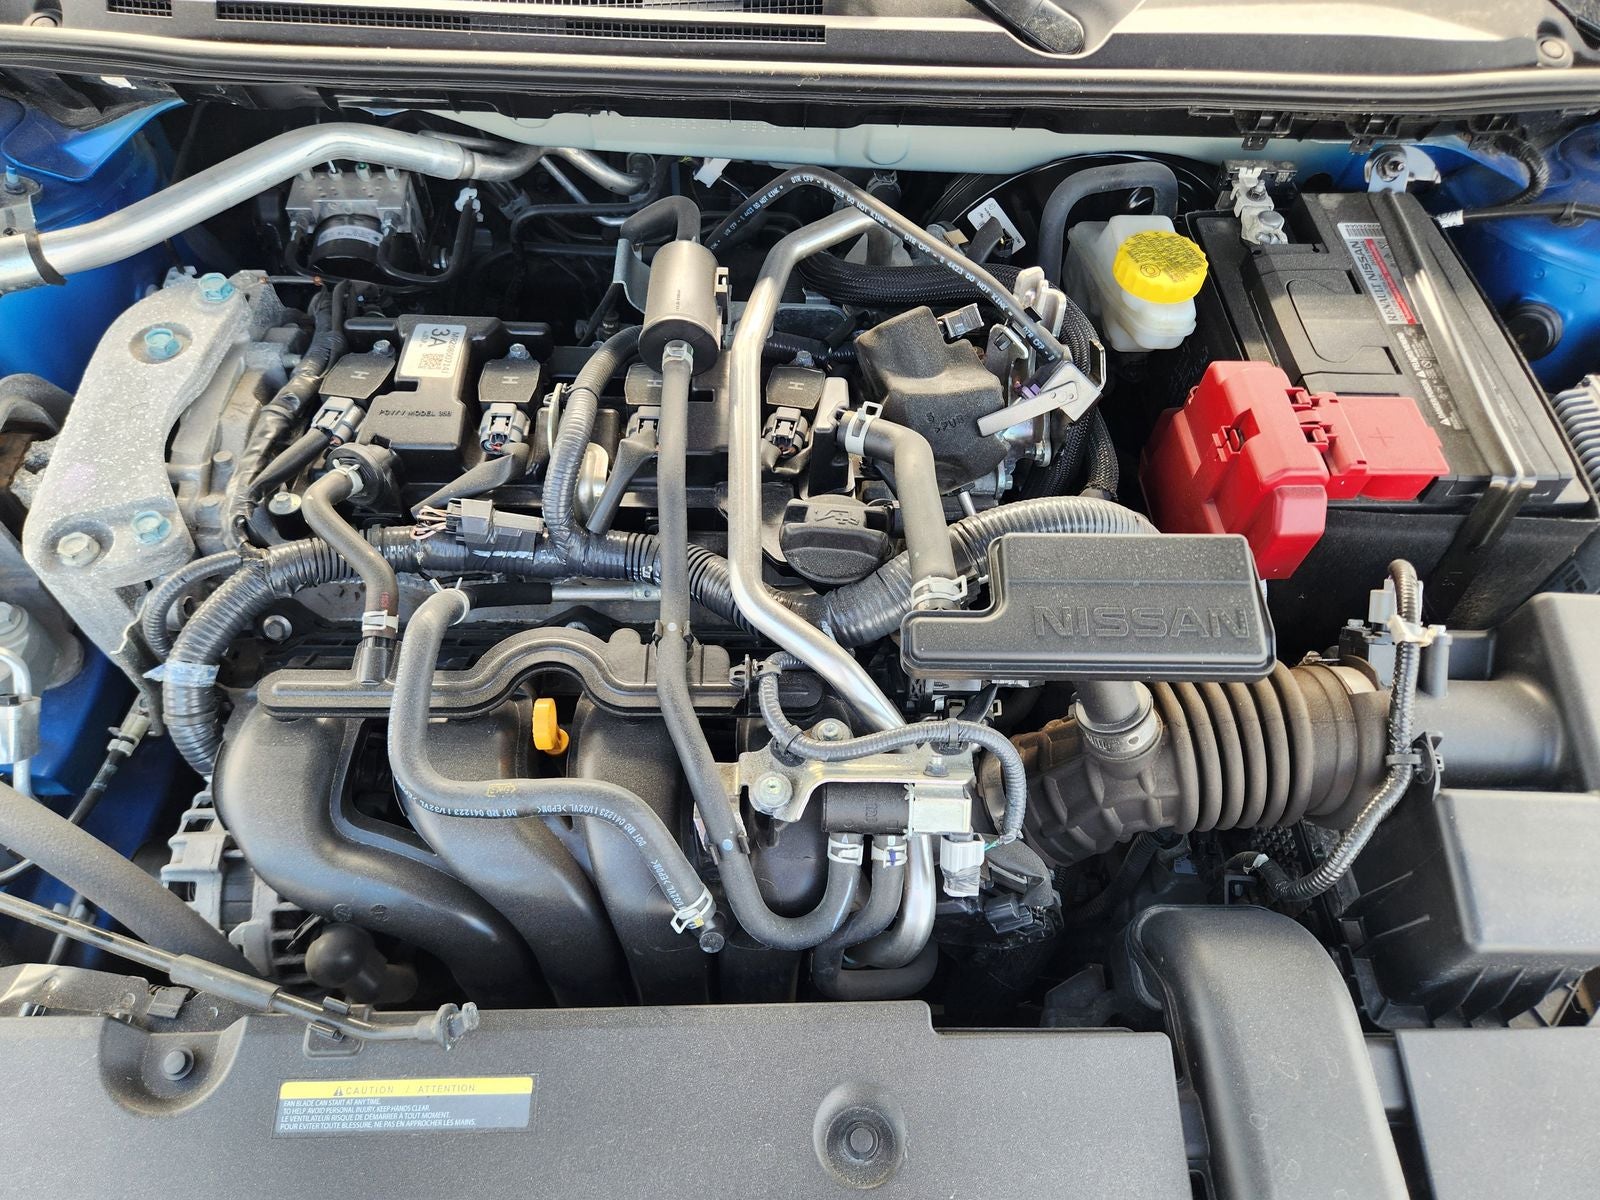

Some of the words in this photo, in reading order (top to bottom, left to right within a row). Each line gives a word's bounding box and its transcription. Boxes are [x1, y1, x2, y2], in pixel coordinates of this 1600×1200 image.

[857, 201, 868, 213] NOT
[1350, 240, 1377, 281] NISSAN
[947, 260, 964, 275] 4423
[965, 272, 976, 282] DO
[976, 281, 991, 294] NOT
[991, 294, 1008, 311] KINK
[1371, 284, 1398, 321] RENAULT
[427, 328, 450, 347] 3A
[1034, 606, 1249, 638] NISSAN
[454, 808, 484, 816] 041223
[502, 808, 517, 817] DOT
[599, 808, 626, 826] 041223
[632, 834, 648, 847] DOT
[345, 1086, 394, 1095] CAUTION
[417, 1084, 476, 1094] ATTENTION
[296, 1099, 316, 1107] BLADE
[292, 1107, 306, 1115] HELP
[326, 1106, 356, 1114] PERSONAL
[376, 1105, 391, 1113] KEEP
[281, 1115, 288, 1123] LE
[289, 1115, 330, 1123] VENTILATEUR
[330, 1114, 354, 1122] RISQUE
[320, 1121, 341, 1129] TOUTE
[373, 1120, 383, 1128] NE
[404, 1119, 443, 1127] APPROCHER
[443, 1118, 454, 1126] LES
